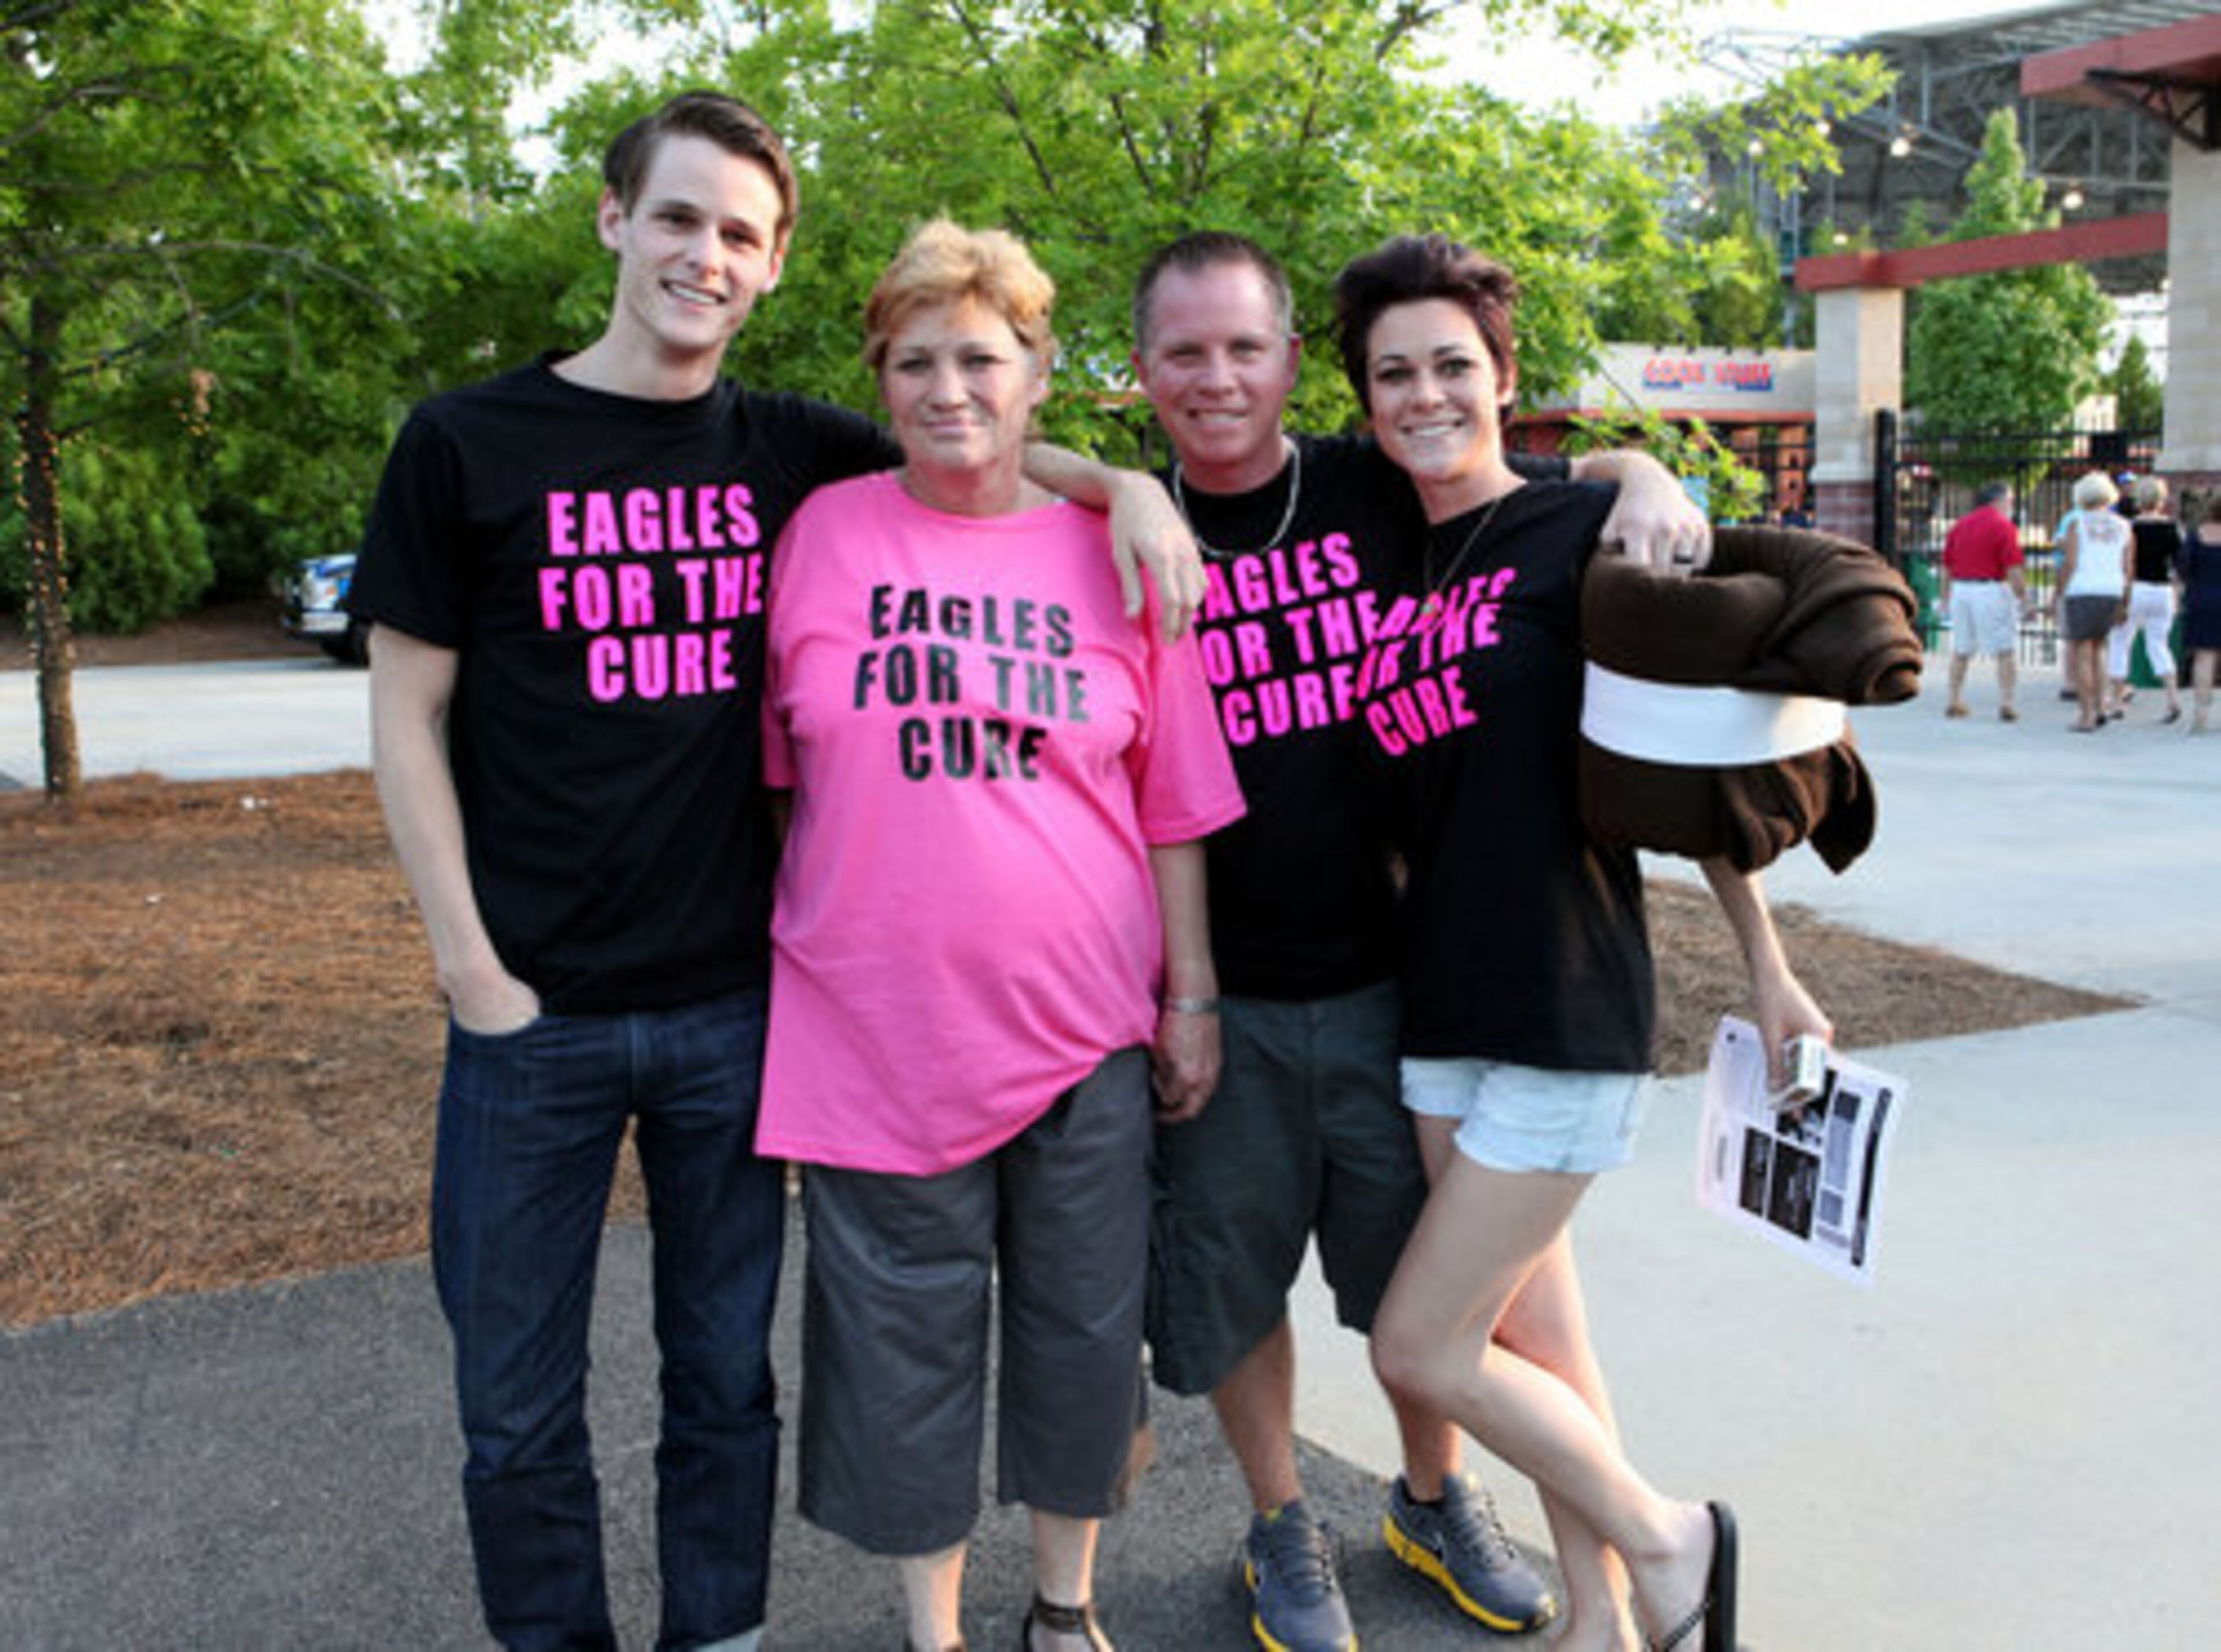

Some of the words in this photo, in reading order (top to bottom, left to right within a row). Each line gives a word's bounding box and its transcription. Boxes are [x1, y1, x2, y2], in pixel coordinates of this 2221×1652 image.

[547, 483, 761, 556] EAGLES
[538, 562, 655, 631] FOR
[676, 552, 763, 623] THE
[1194, 532, 1360, 623] AGLES
[870, 583, 1074, 658] EAGLES
[1200, 620, 1272, 688] OR
[587, 629, 737, 704] CURE
[853, 643, 960, 710] FOR
[987, 653, 1090, 723] THE
[1366, 665, 1478, 755] CURE
[898, 716, 1048, 781] CURE
